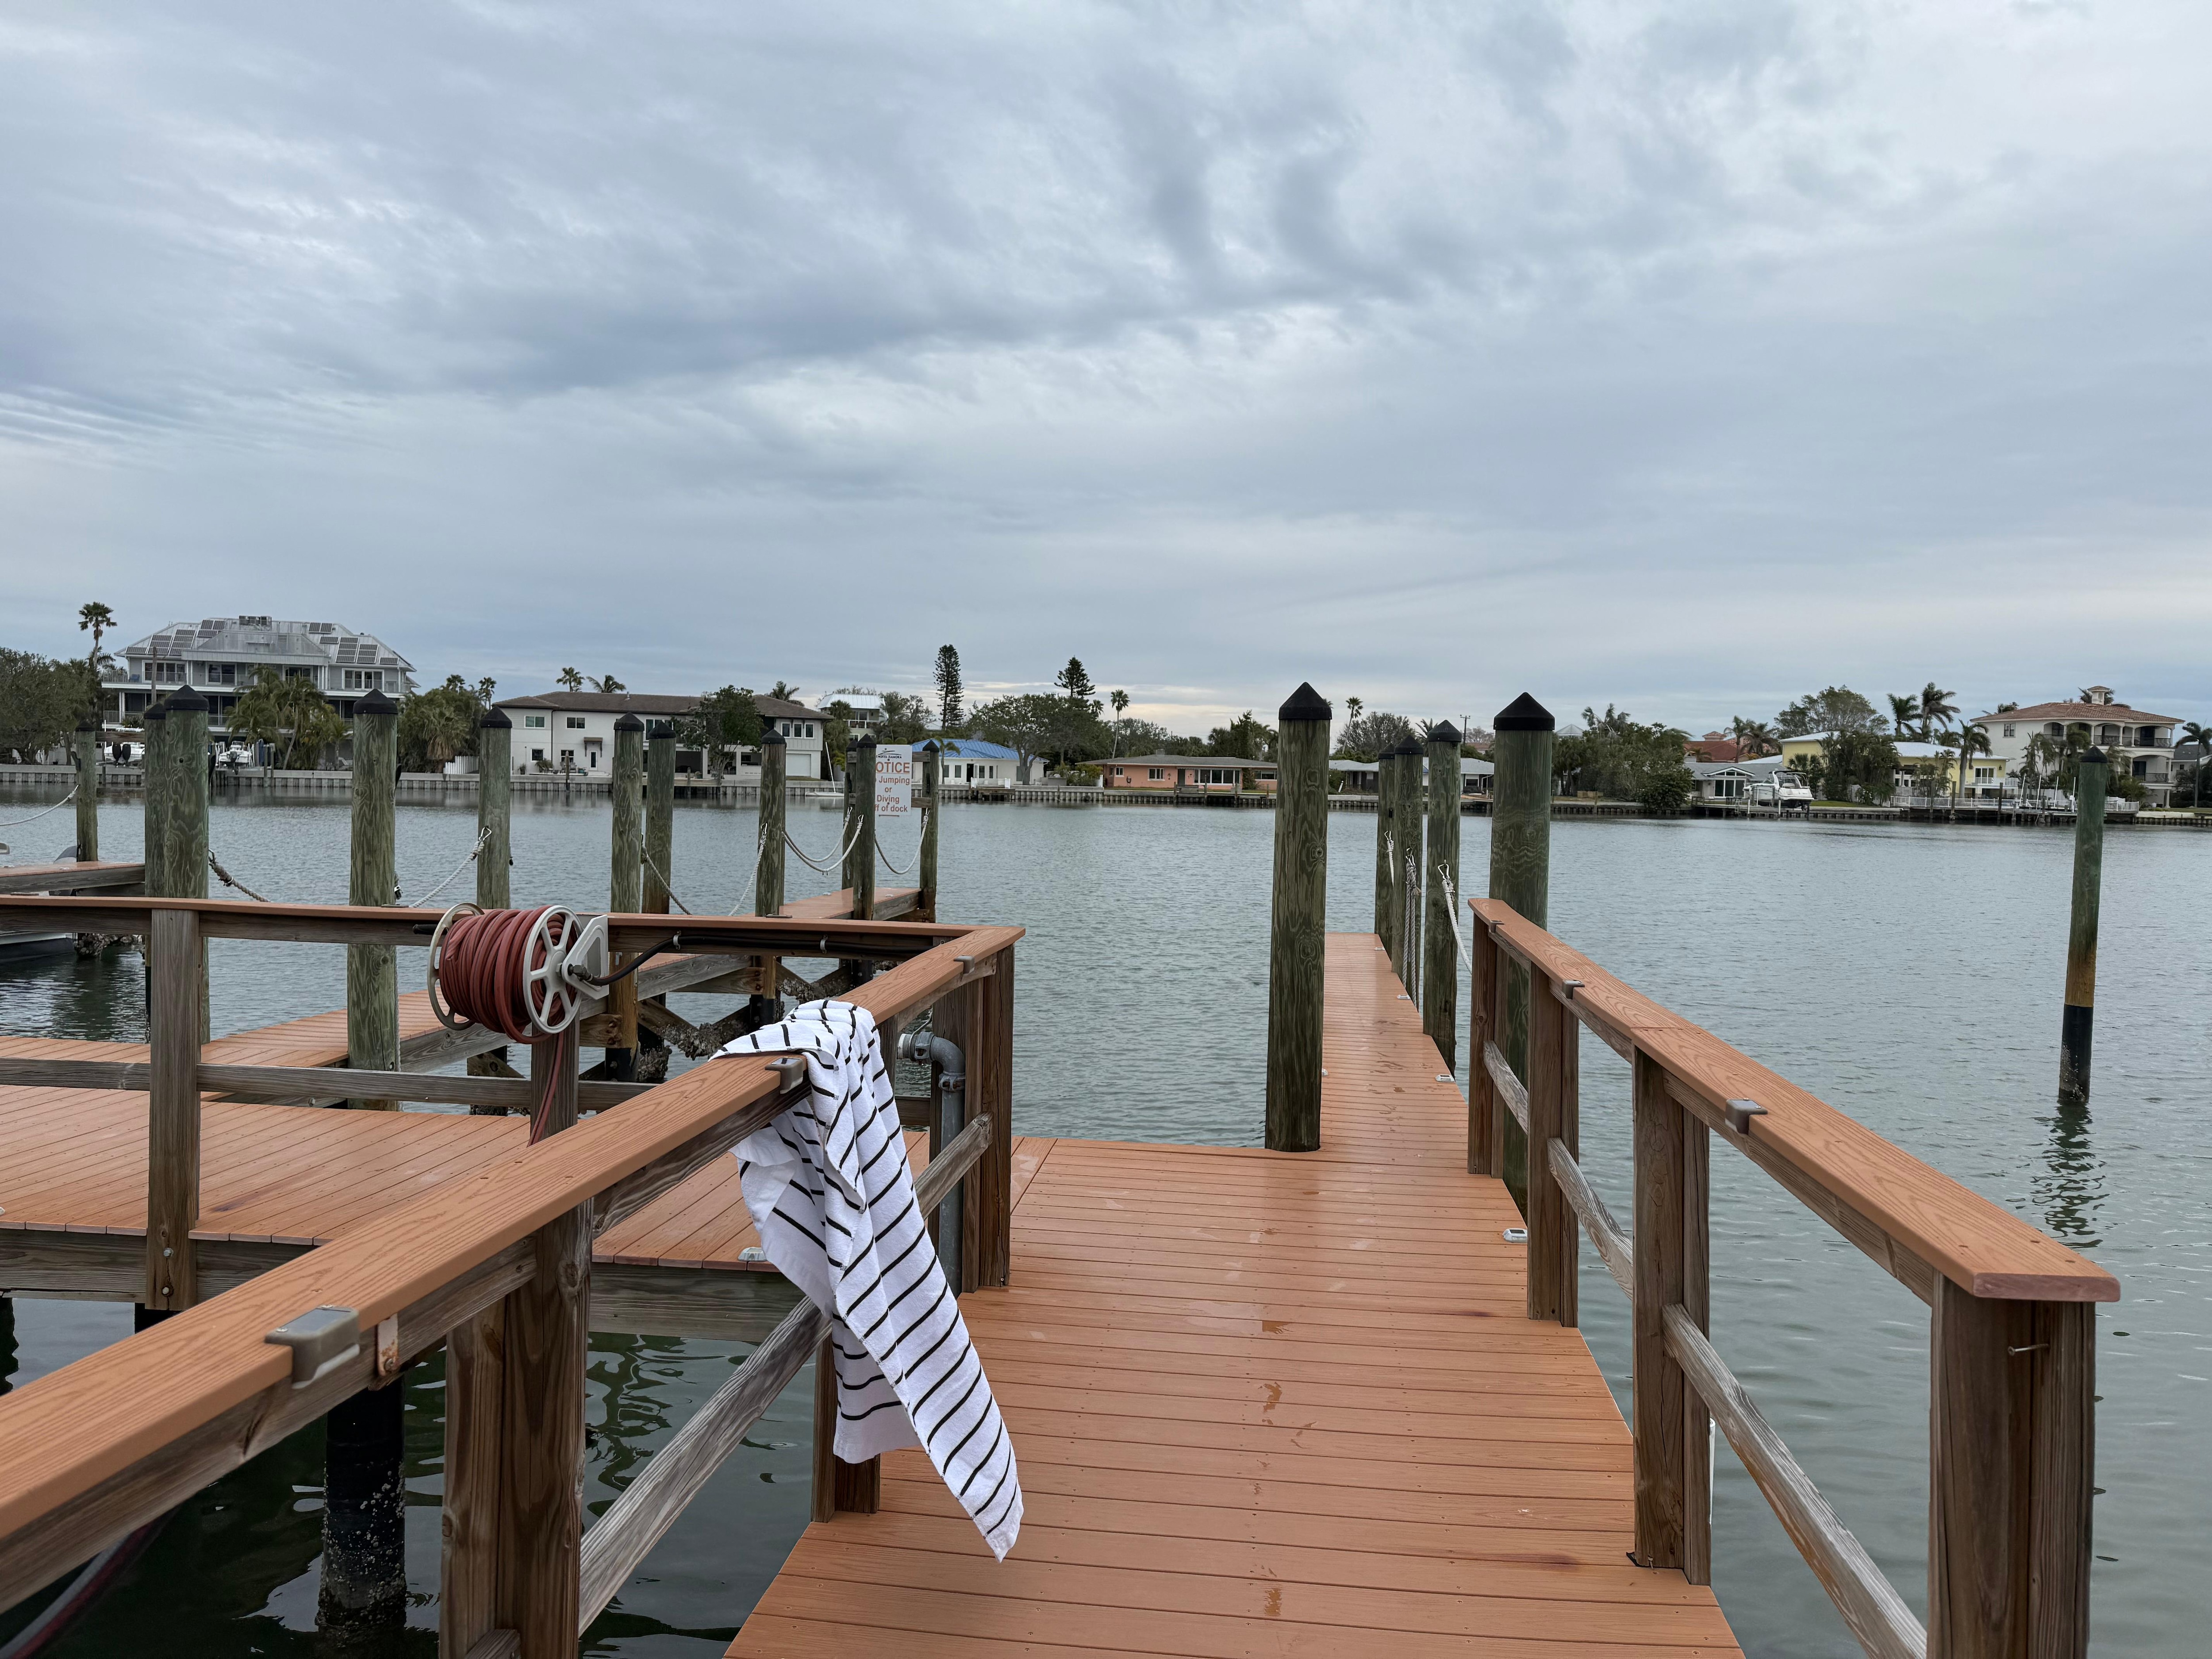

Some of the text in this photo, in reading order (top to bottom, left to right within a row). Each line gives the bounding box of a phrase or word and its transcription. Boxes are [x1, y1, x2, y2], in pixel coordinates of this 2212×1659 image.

[875, 761, 910, 773] OTICE
[879, 776, 910, 785] Jumping
[877, 795, 899, 804] Diving
